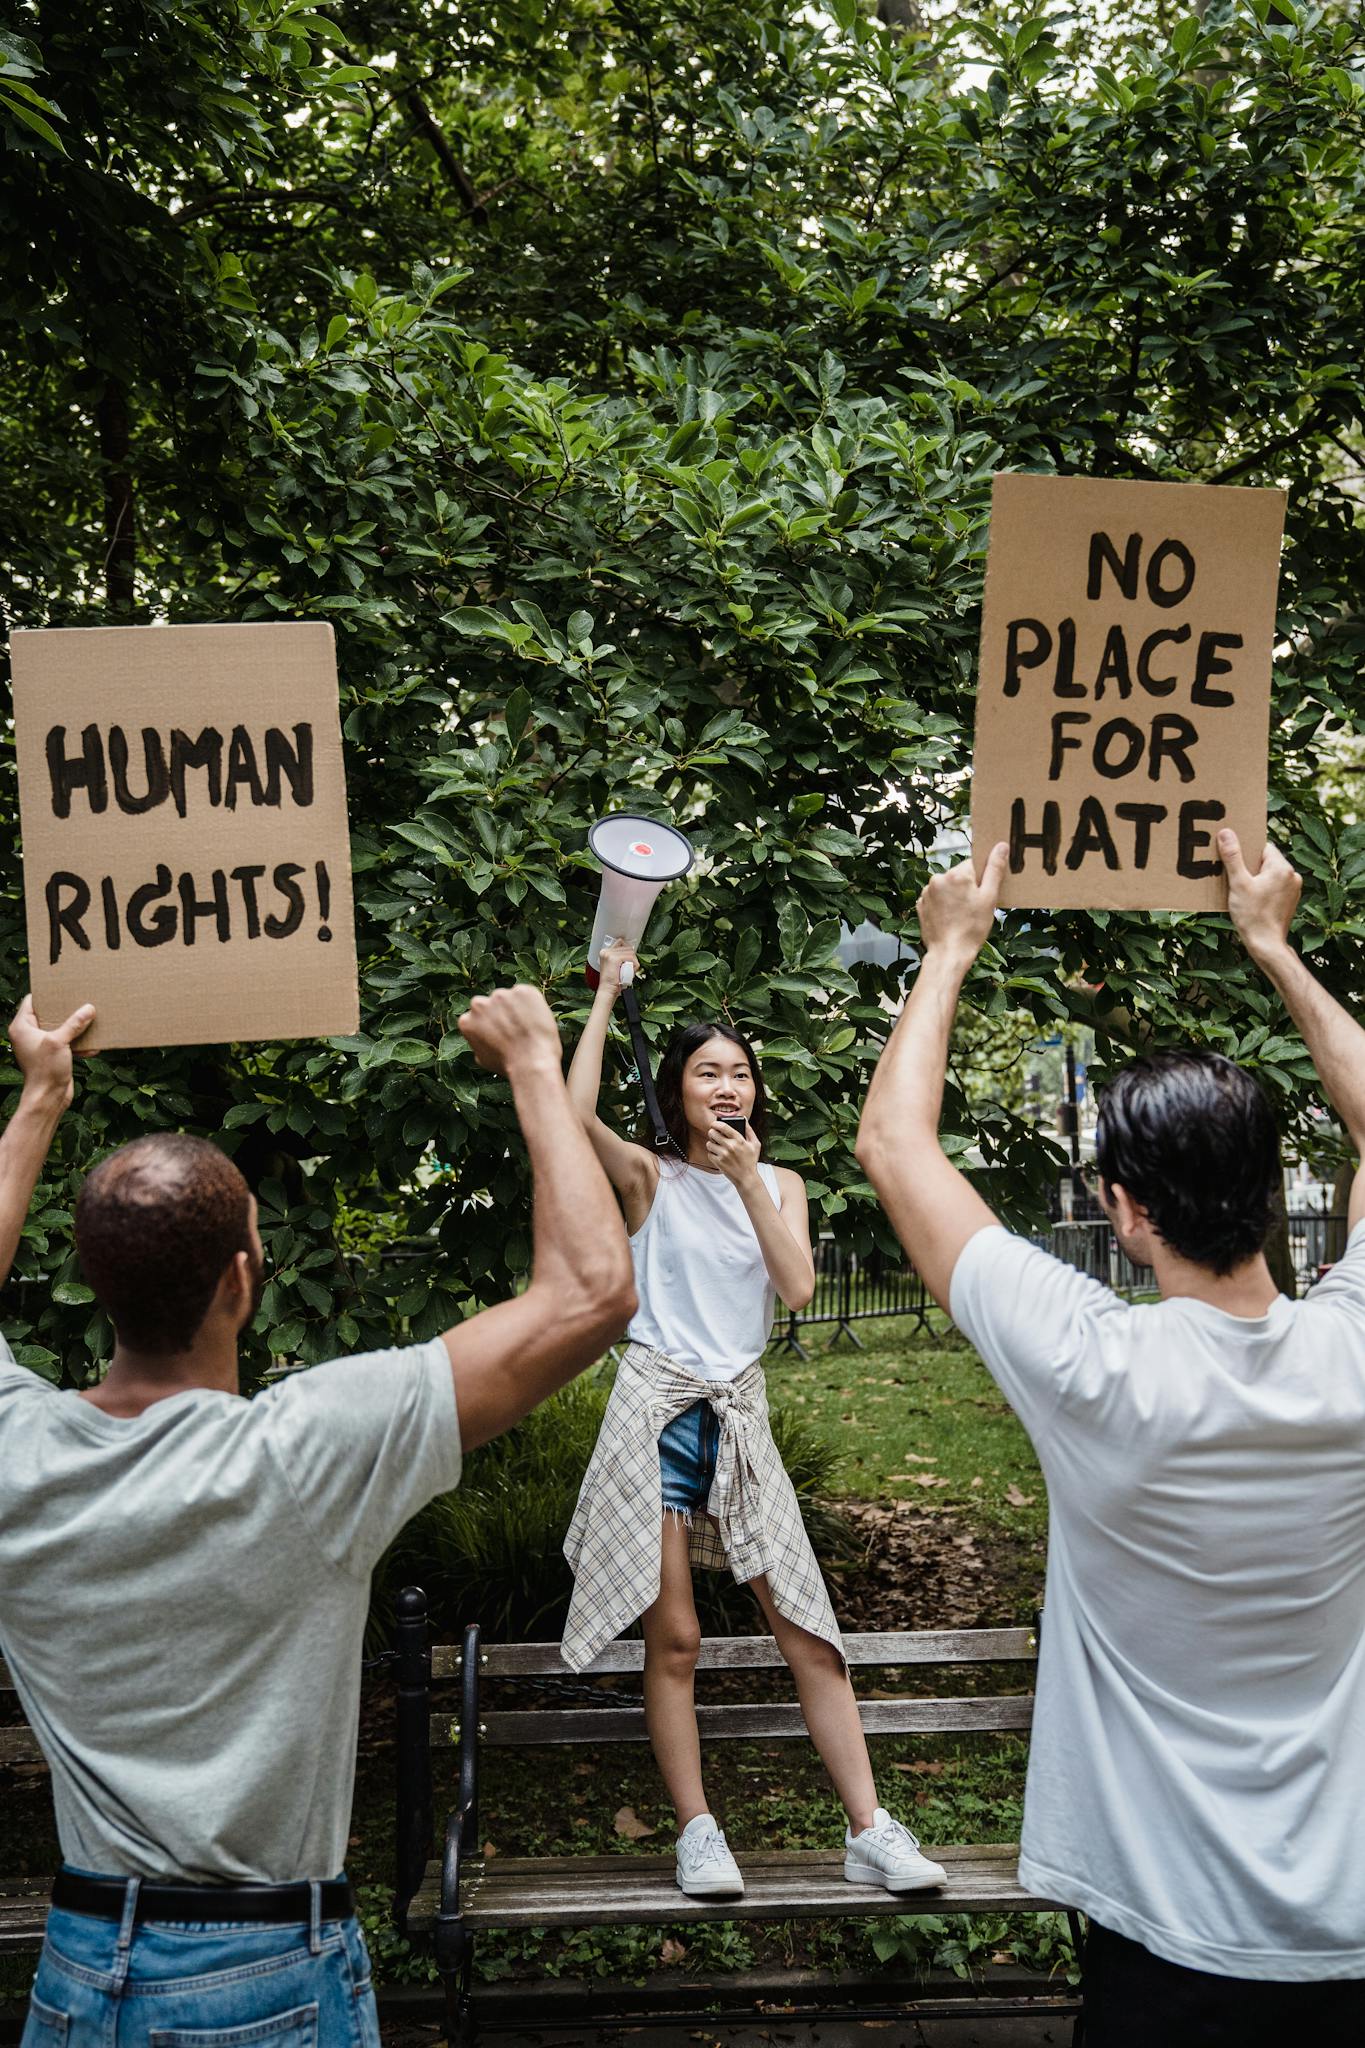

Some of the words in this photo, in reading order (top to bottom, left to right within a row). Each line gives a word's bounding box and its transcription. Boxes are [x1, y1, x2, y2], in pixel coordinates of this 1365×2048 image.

[1086, 530, 1196, 609] NO
[1002, 616, 1244, 708] PLACE
[45, 722, 314, 820] HUMAN
[1048, 710, 1200, 784] FOR
[1008, 794, 1226, 879] HATE
[45, 860, 333, 966] RIGHTS!
